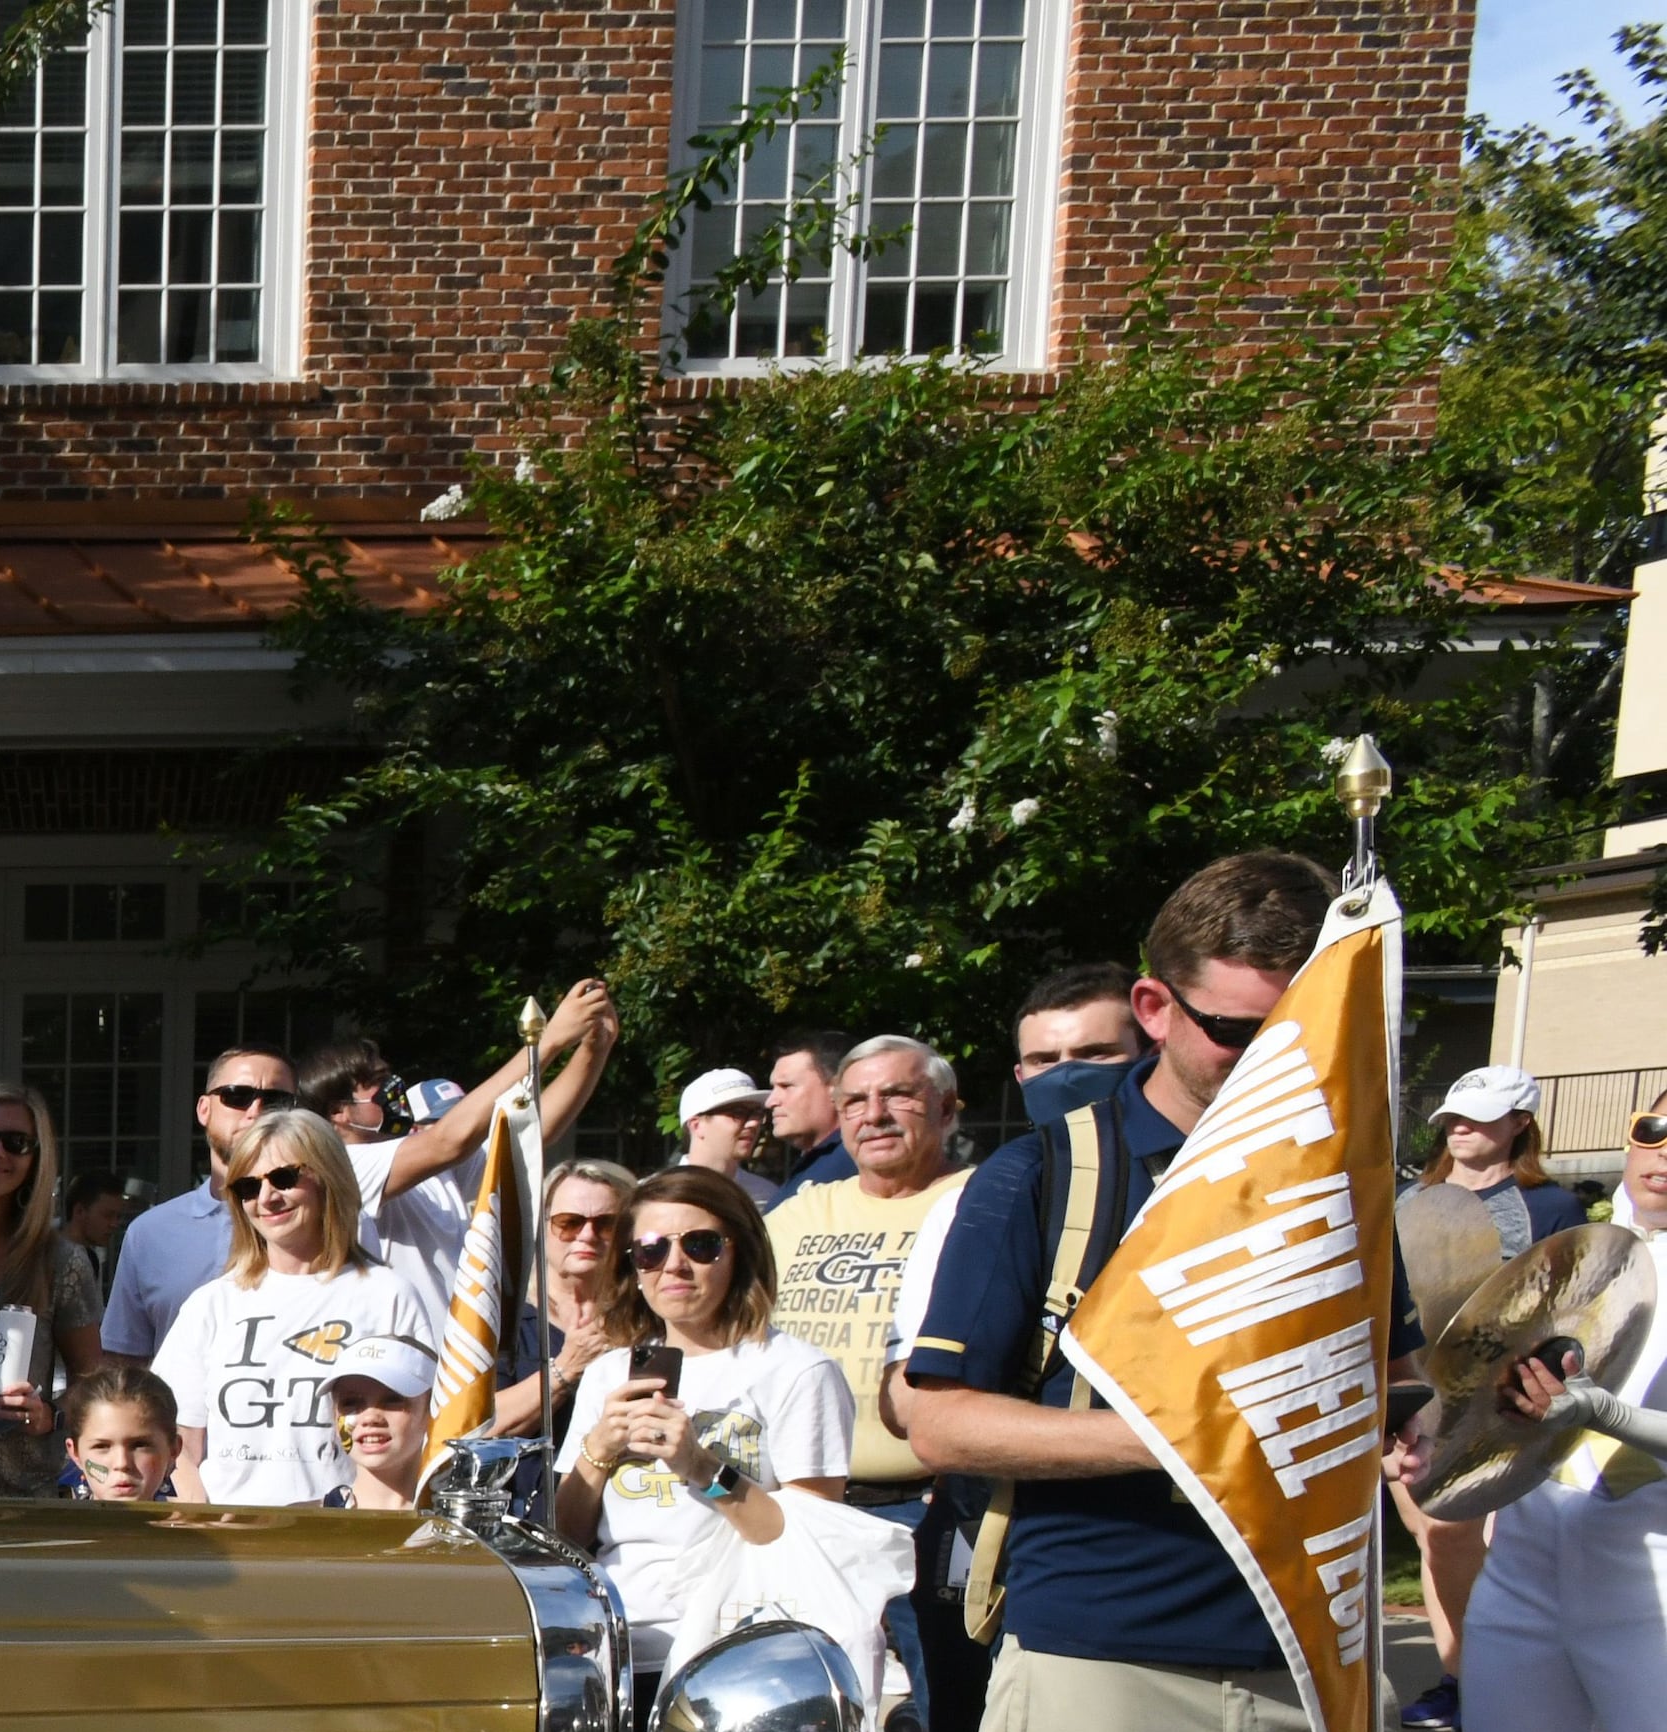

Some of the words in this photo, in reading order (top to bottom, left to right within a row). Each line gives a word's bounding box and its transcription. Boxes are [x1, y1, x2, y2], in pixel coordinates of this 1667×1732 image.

[796, 1232, 886, 1257] GEORGIA
[815, 1251, 902, 1294] GT
[224, 1315, 276, 1368] I
[218, 1377, 333, 1429] GT
[1217, 1317, 1380, 1500] HELL
[611, 1458, 688, 1507] GT
